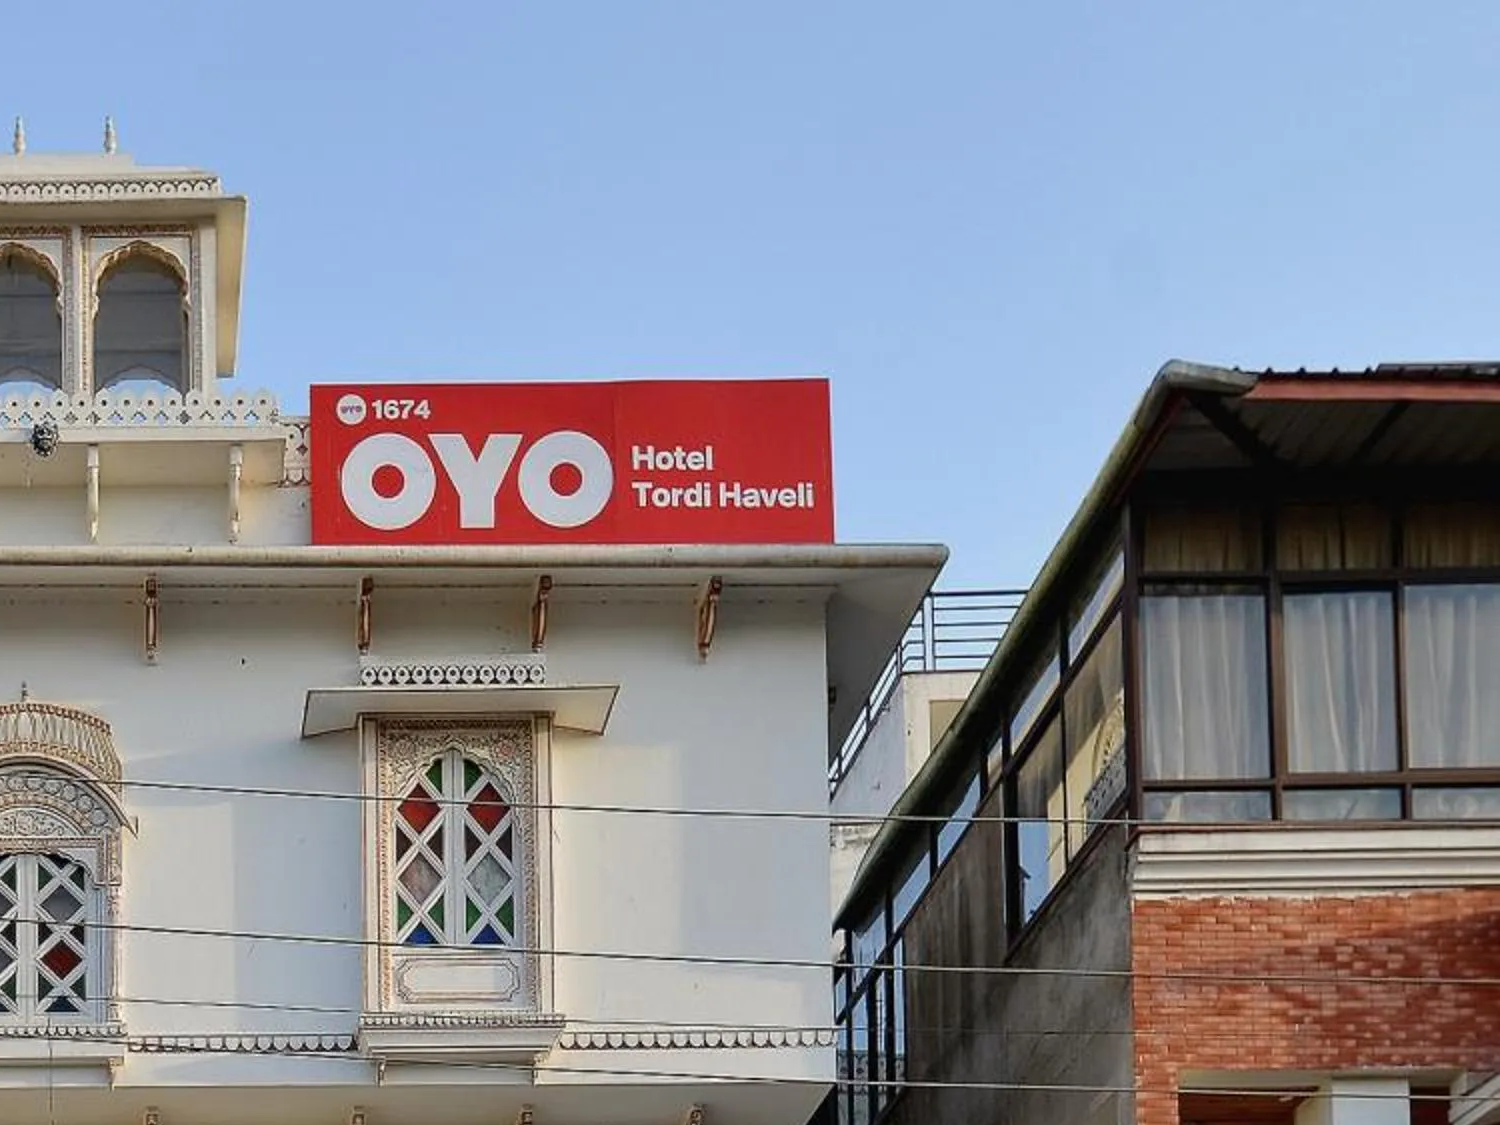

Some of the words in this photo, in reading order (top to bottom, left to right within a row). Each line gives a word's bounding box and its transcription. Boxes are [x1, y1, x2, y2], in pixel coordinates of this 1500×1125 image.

[371, 399, 431, 419] 1674
[631, 445, 713, 471] Hotel
[341, 430, 614, 530] OYO
[631, 482, 711, 507] Tordi
[719, 482, 814, 507] Haveli
